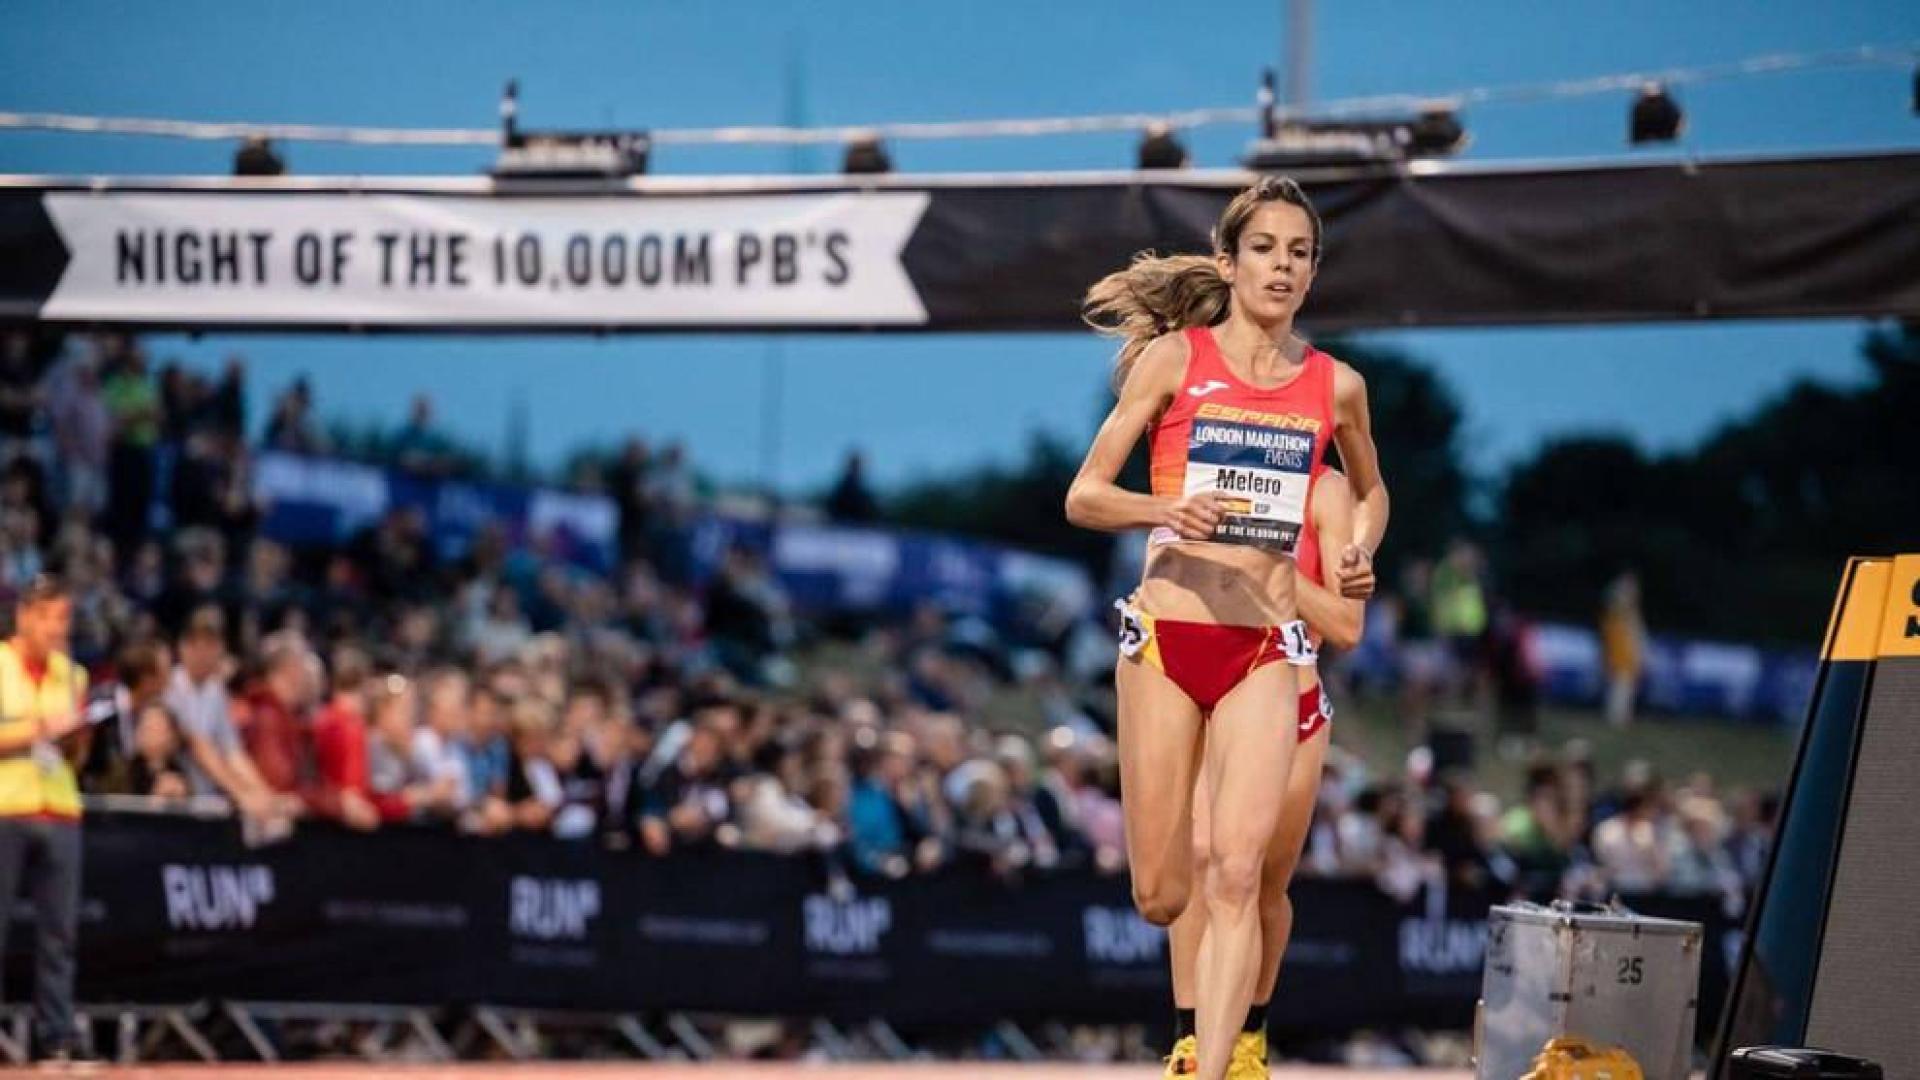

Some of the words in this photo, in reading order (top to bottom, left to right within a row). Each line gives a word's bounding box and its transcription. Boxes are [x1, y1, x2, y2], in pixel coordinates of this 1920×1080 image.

[115, 230, 273, 287] NIGHT
[294, 232, 353, 287] OF
[376, 233, 470, 287] THE
[736, 231, 850, 288] PB'S
[1196, 426, 1244, 445] LONDON
[1246, 430, 1311, 452] MARATHON
[1263, 449, 1304, 468] EVENTS
[1215, 468, 1281, 496] Melero
[1616, 956, 1644, 985] 25
